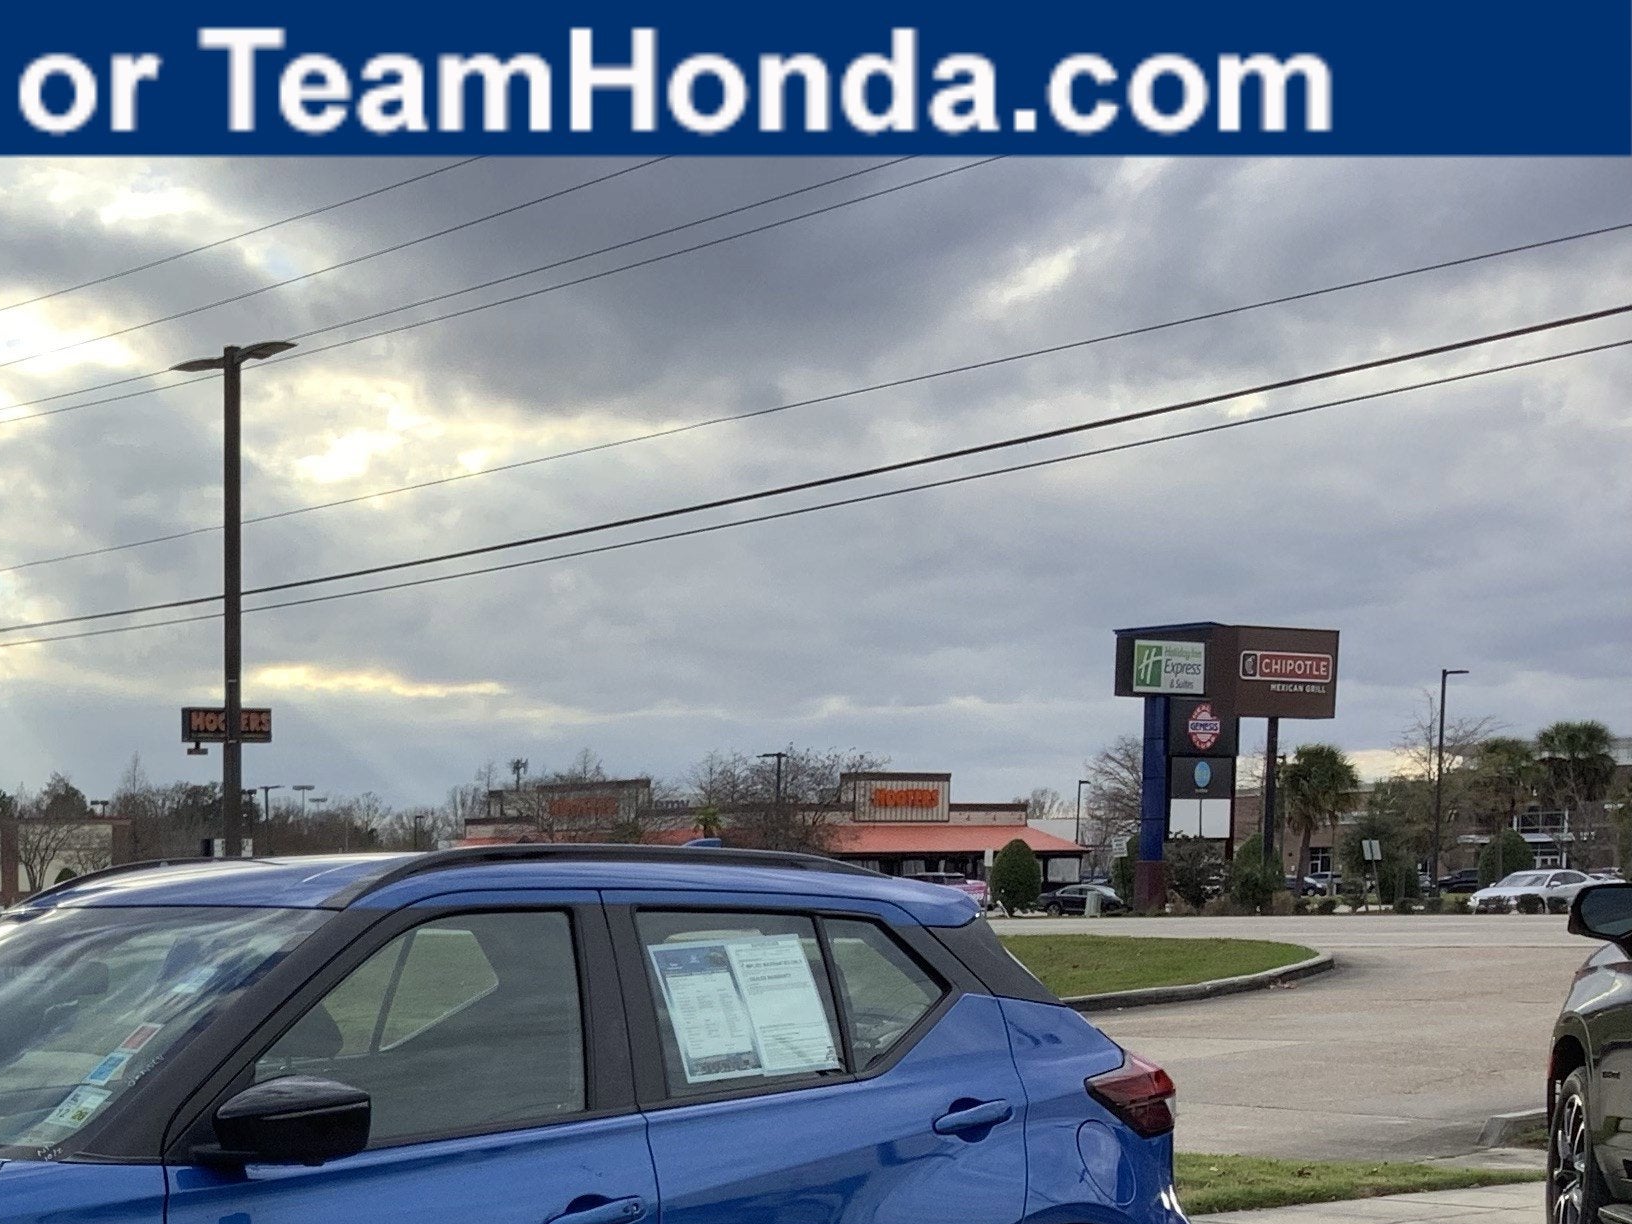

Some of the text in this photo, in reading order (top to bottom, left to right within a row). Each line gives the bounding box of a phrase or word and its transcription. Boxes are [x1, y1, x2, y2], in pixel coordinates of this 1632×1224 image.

[1164, 658, 1202, 678] Express
[1261, 657, 1328, 677] CHIPOTLE
[1270, 683, 1327, 693] MEXICAN GRILL
[1190, 722, 1219, 732] GENESIS
